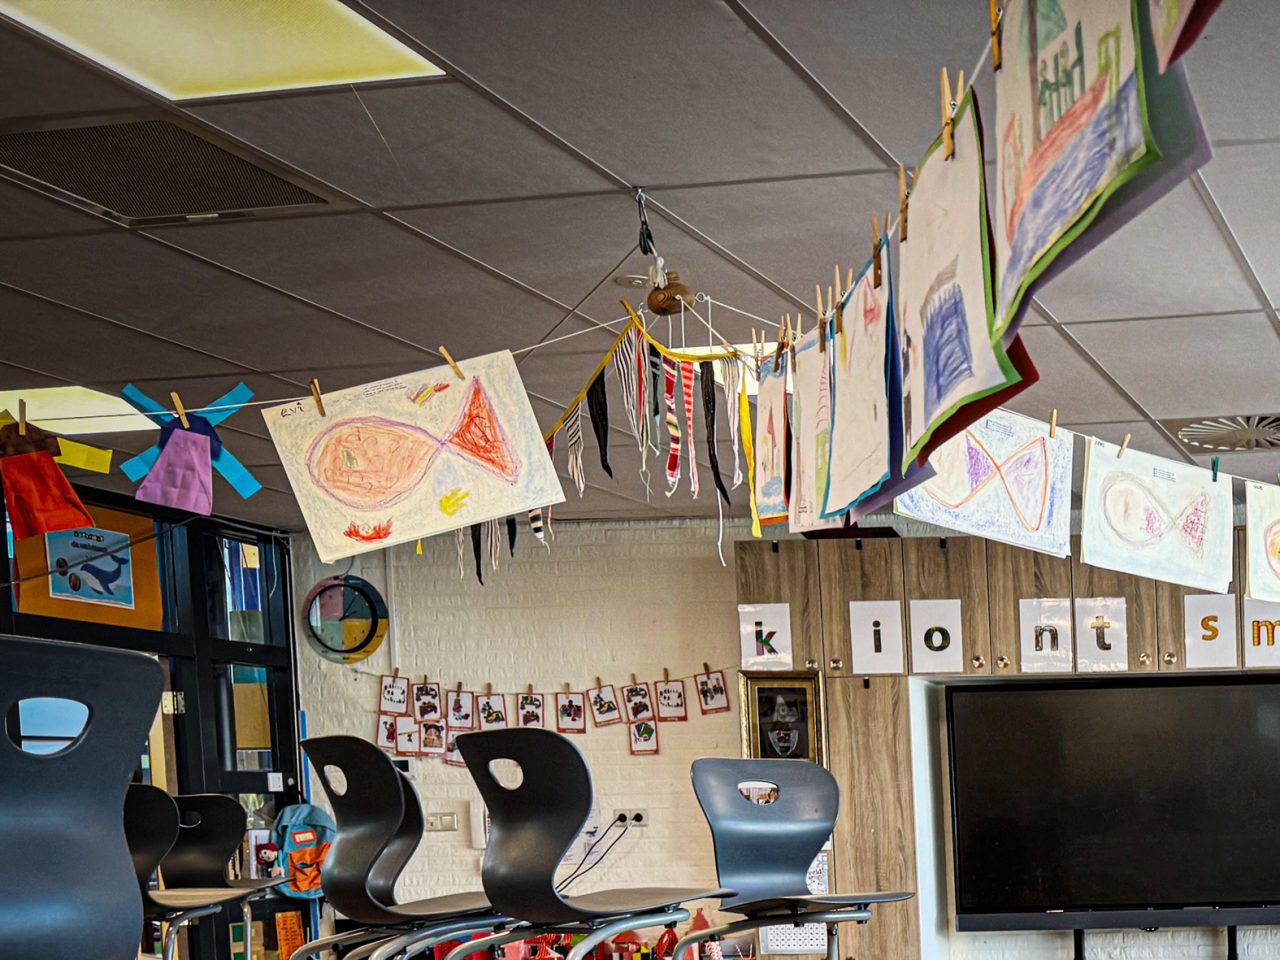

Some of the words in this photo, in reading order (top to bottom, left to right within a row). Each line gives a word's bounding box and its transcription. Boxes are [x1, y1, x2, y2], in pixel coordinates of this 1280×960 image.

[755, 621, 779, 656] k
[872, 620, 882, 653] i
[924, 626, 951, 652] o
[1035, 625, 1059, 652] n
[1090, 615, 1112, 650] t
[1200, 615, 1219, 641] s
